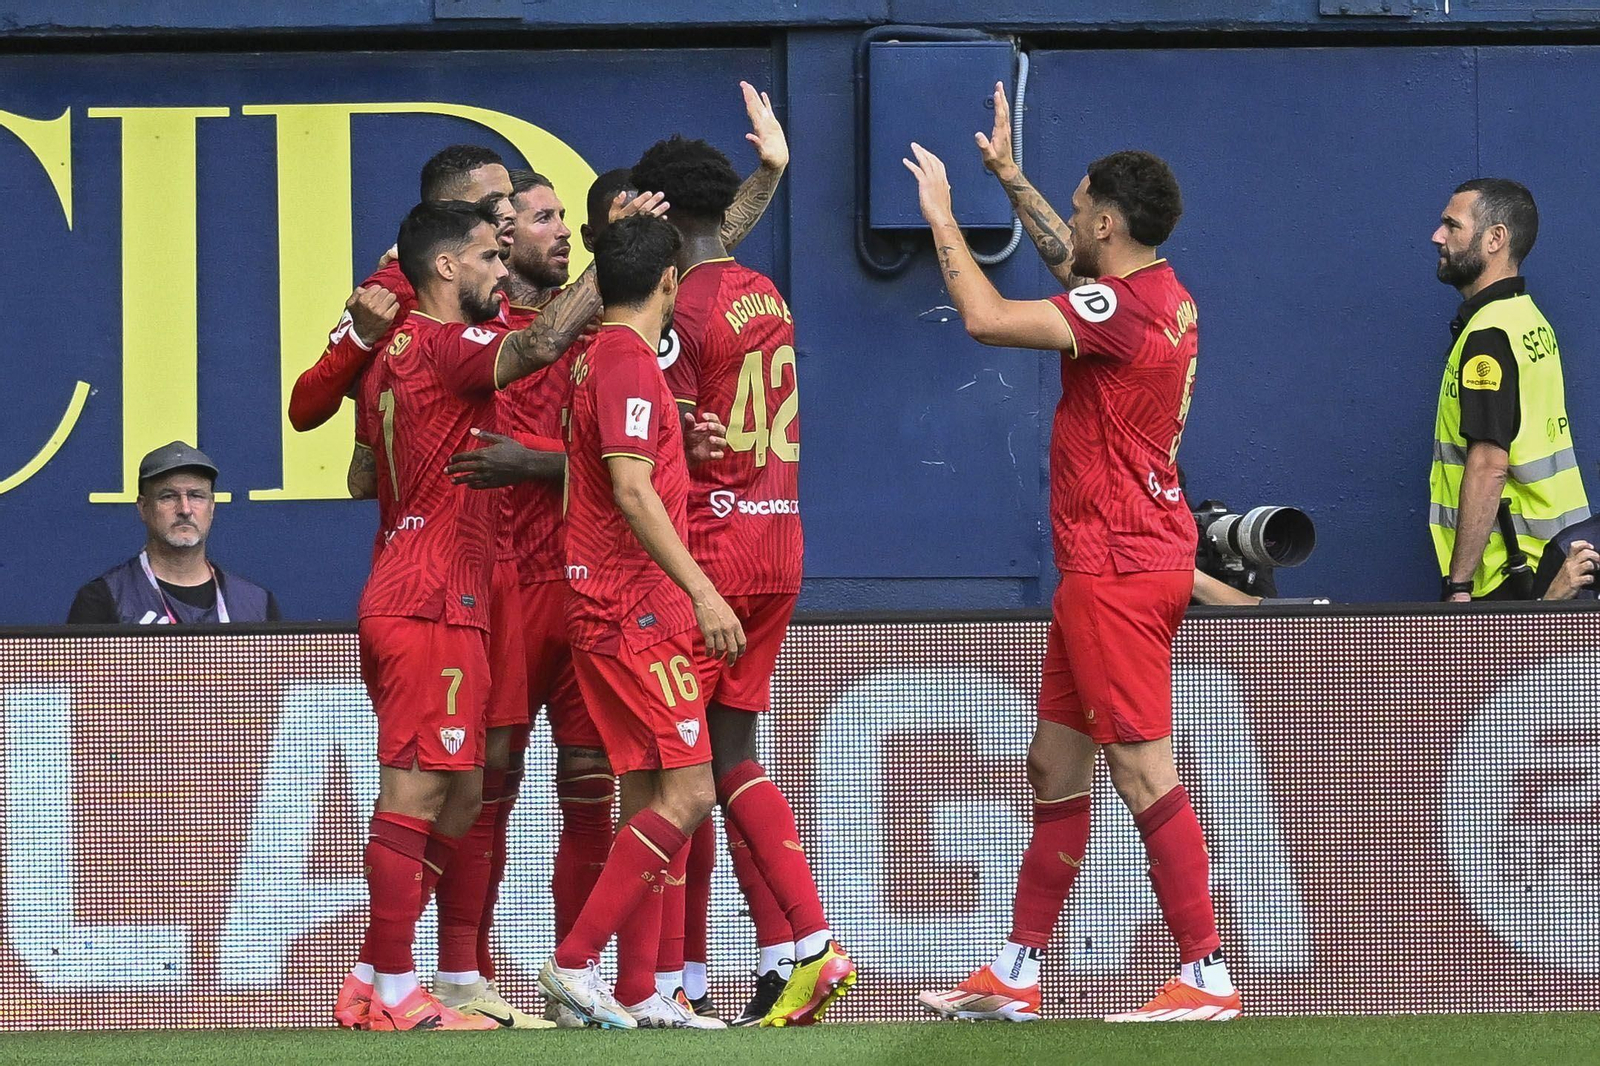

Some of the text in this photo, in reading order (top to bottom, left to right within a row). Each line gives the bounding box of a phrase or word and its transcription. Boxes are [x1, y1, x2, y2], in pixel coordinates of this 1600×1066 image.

[1074, 290, 1110, 314] JD
[726, 345, 799, 467] 42
[441, 668, 464, 715] 7
[649, 655, 699, 708] 16
